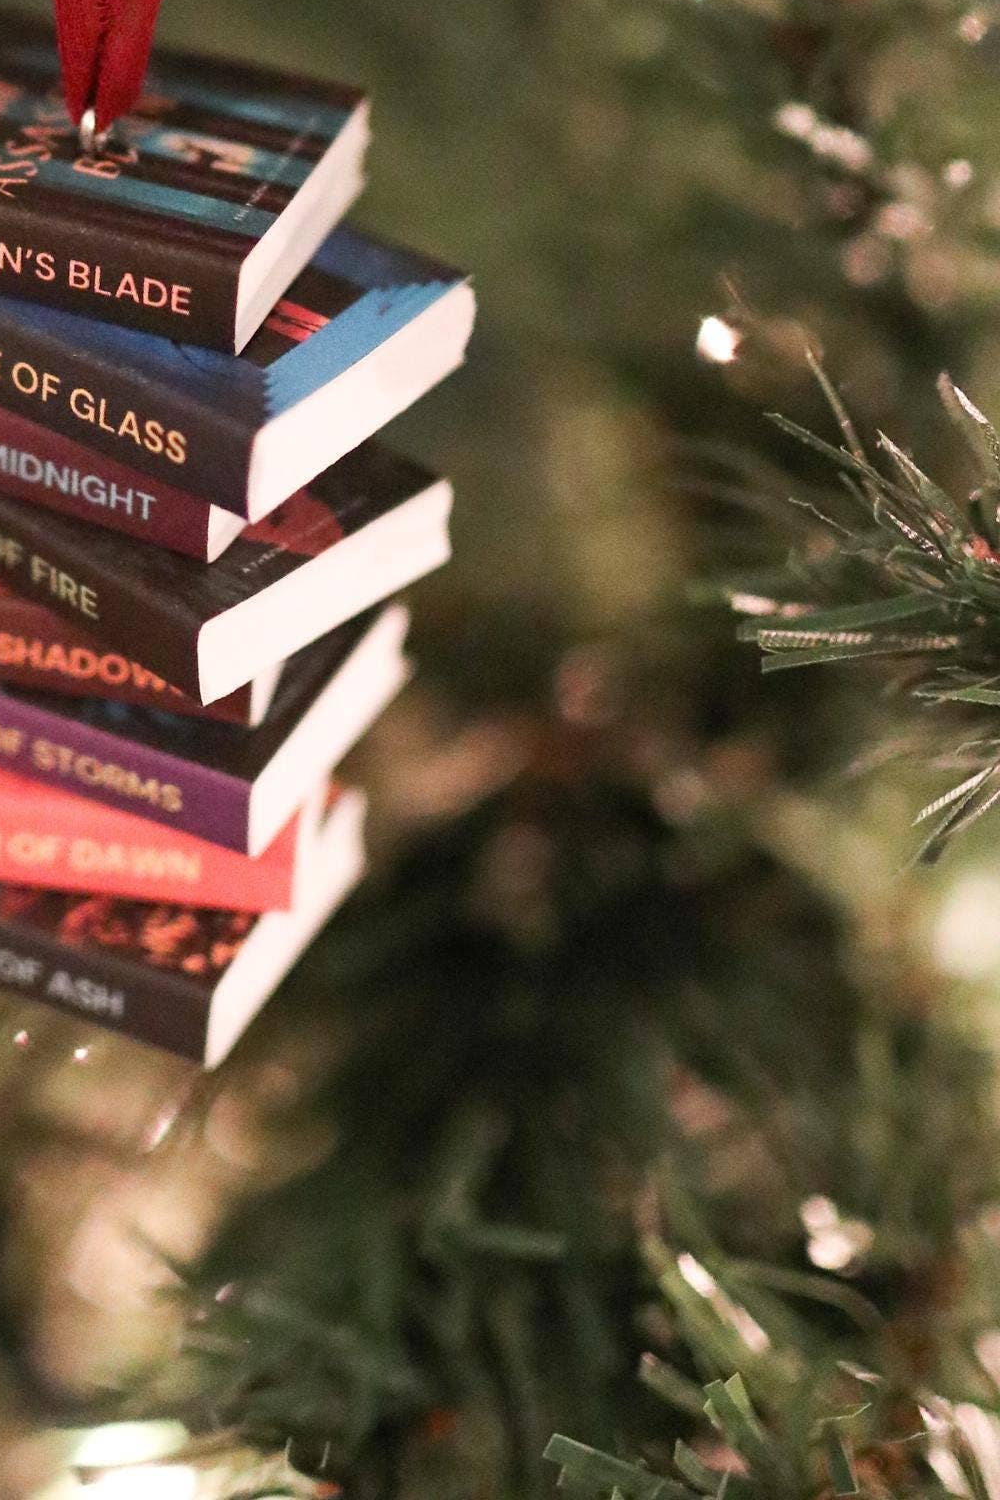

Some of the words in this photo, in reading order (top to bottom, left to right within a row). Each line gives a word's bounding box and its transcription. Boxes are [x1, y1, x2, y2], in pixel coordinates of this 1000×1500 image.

[68, 259, 192, 316] BLADE
[11, 362, 61, 401] OF
[69, 388, 187, 464] GLASS
[30, 554, 100, 620] FIRE
[31, 738, 184, 813] STORMS
[6, 831, 61, 865] OF
[48, 970, 126, 1017] ASH
